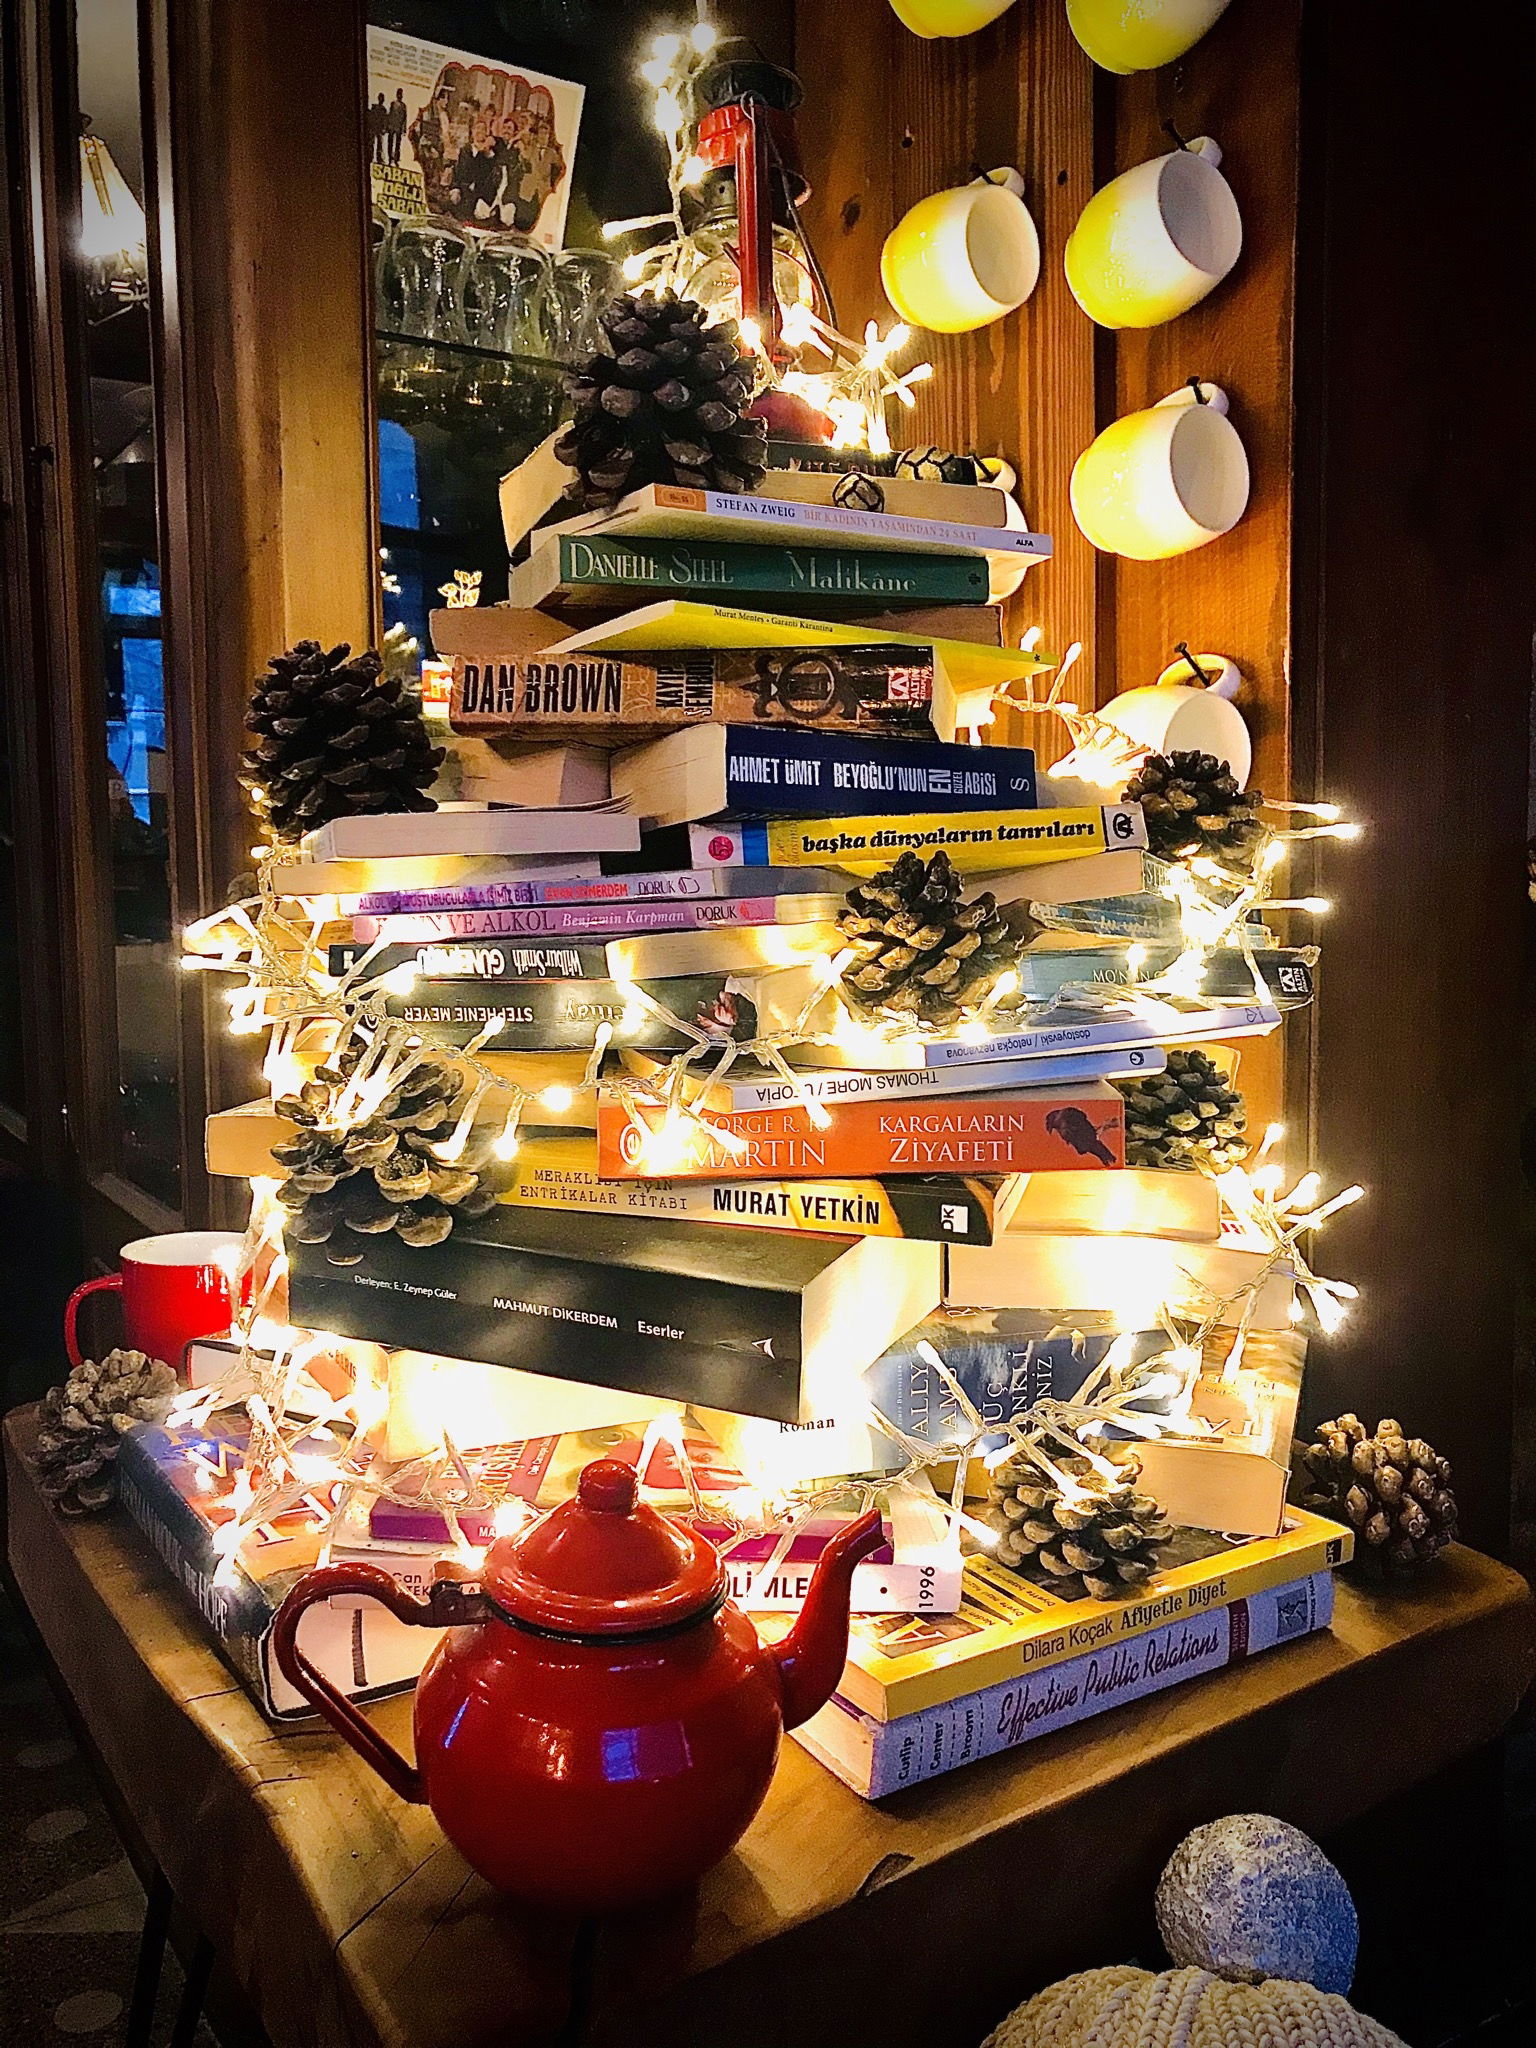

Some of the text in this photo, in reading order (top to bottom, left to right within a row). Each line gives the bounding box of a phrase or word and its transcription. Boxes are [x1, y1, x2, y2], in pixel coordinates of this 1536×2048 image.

[716, 498, 796, 518] STEFAN ZWEIG
[803, 509, 821, 521] BİR
[953, 529, 977, 541] SAAT
[1016, 539, 1034, 547] ALFA
[785, 551, 917, 592] Malikâne
[714, 608, 737, 620] Murat
[771, 617, 798, 628] Garanti
[799, 621, 834, 633] Karantina
[462, 662, 622, 713] DAN BROWN
[655, 665, 685, 708] KAYIP
[729, 756, 780, 784] AHMET
[785, 759, 821, 786] ÜMİT
[833, 761, 927, 793] BEYOĞLU'NUN
[928, 768, 952, 794] EN
[802, 833, 867, 853] başka
[869, 827, 993, 850] dünyaların
[997, 821, 1095, 841] tanrıları
[638, 880, 676, 895] DORUK
[447, 913, 475, 934] VE
[481, 909, 556, 934] ALKOL
[562, 910, 685, 929] Benjamin Karpman
[696, 905, 738, 921] DORUK
[512, 948, 583, 977] Wilbur Smith
[404, 1006, 450, 1023] MEYER
[997, 1037, 1033, 1053] netoçka
[1042, 1029, 1091, 1045] dostoyevski
[827, 1076, 873, 1095] MORE
[876, 1071, 939, 1088] THOMAS
[783, 1115, 800, 1133] R.
[879, 1114, 1025, 1134] KARGALARIN
[687, 1139, 826, 1169] MARTIN
[889, 1136, 1014, 1164] ZİYAFETİ
[519, 1185, 688, 1211] ENTRİKALAR KİTABI
[713, 1188, 880, 1225] MURAT YETKİN
[403, 1283, 433, 1298] Zeynep
[434, 1288, 458, 1300] Güler
[493, 1297, 685, 1340] MAHMUT DİKERDEM Eserler
[910, 1362, 930, 1437] ALLY
[979, 1382, 1008, 1422] ÜÇ
[780, 1418, 835, 1434] Roman
[918, 1566, 935, 1608] 1996
[199, 1571, 229, 1643] HOPE
[1023, 1578, 1227, 1664] Dilara Koçak Afiyetle Diyet
[997, 1626, 1220, 1744] Effective Public Relations
[929, 1722, 944, 1771] Center
[960, 1709, 974, 1760] Broom
[898, 1736, 915, 1780] Cutlip
